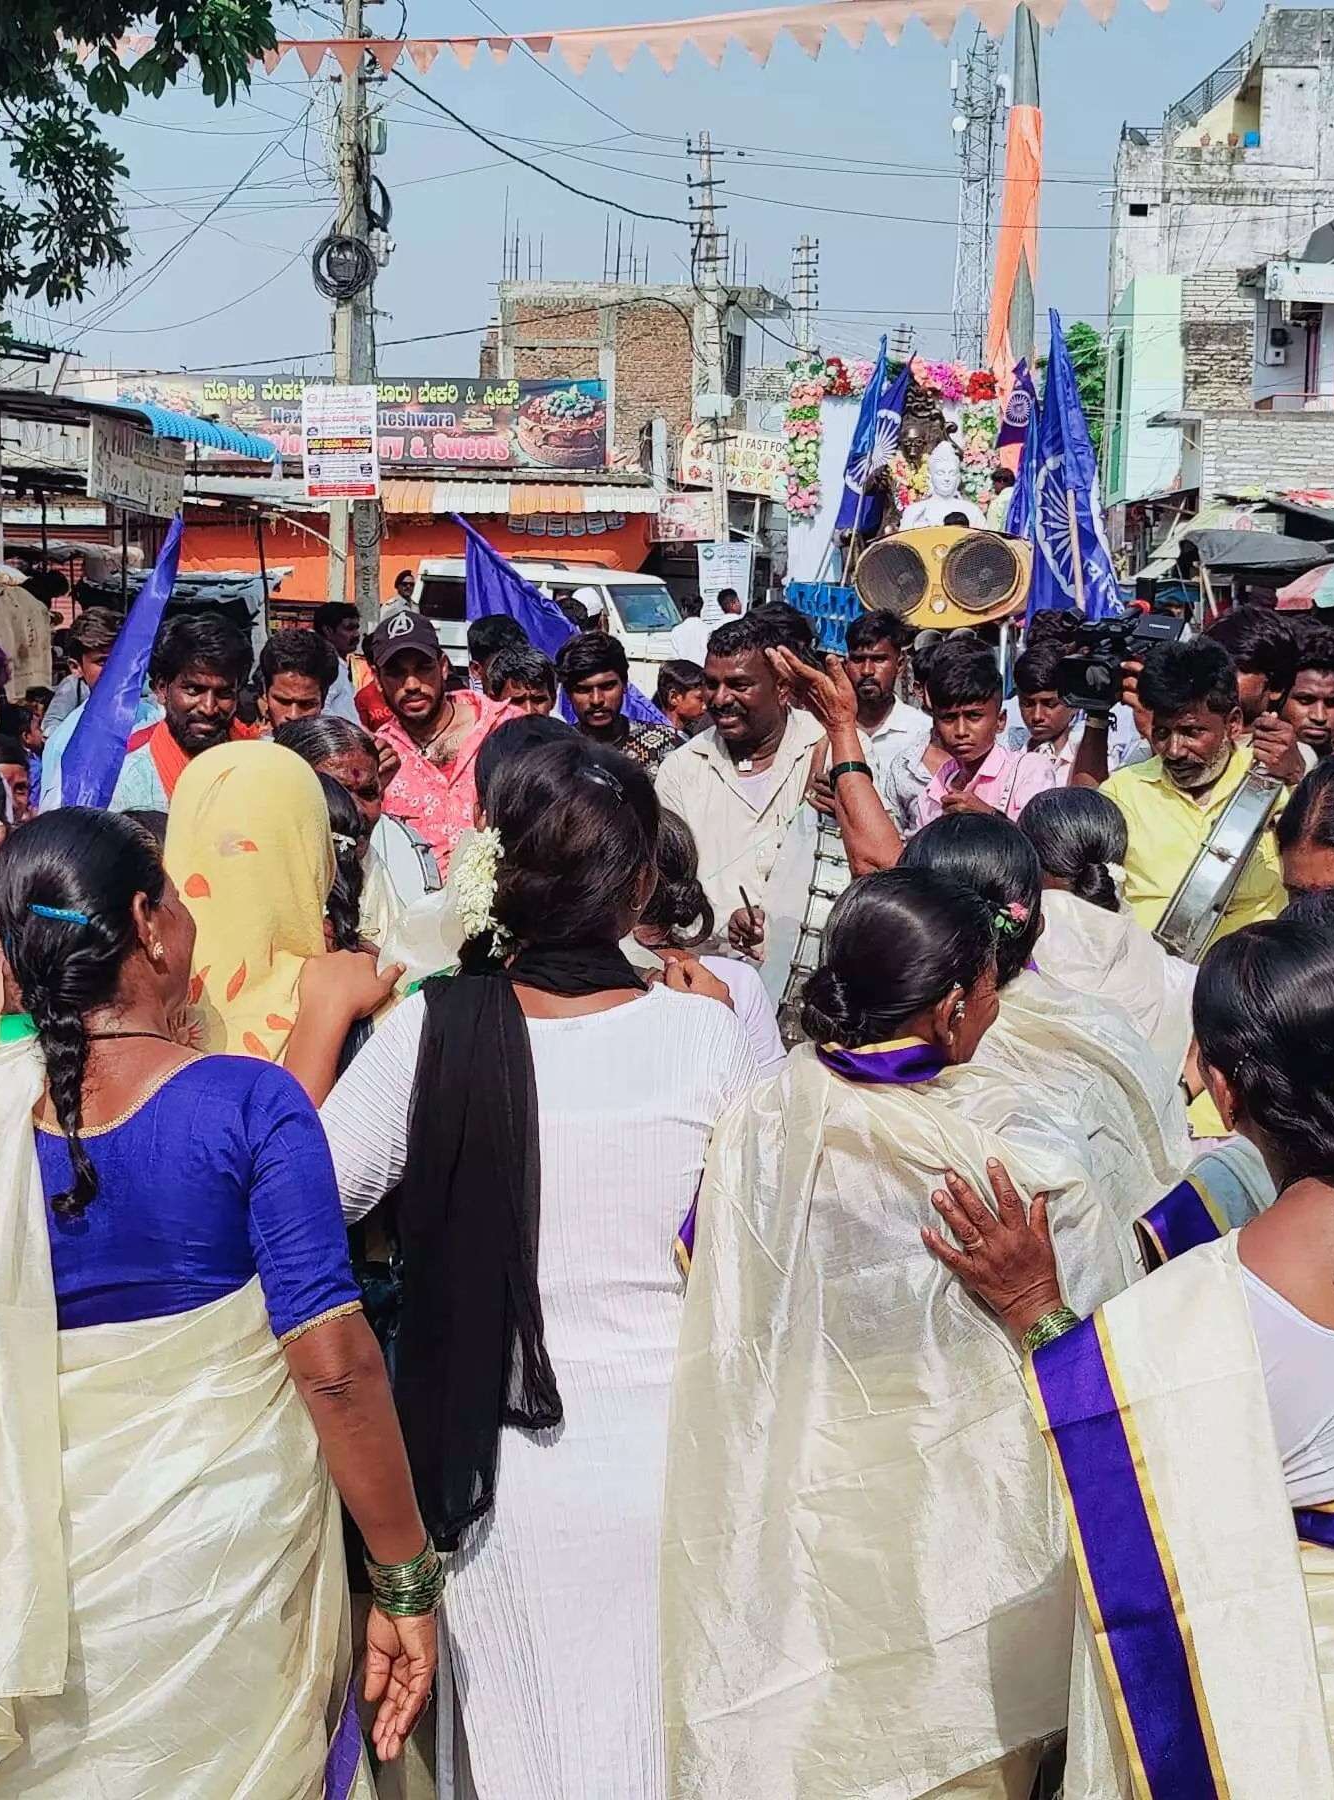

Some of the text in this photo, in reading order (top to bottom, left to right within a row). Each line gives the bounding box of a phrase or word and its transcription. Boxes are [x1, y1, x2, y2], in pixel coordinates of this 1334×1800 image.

[418, 380, 459, 404] ಬೇಕರಿ
[465, 385, 477, 404] &
[377, 411, 456, 430] teshwara
[409, 436, 428, 460] &
[432, 433, 510, 461] Sweets
[746, 437, 769, 451] FAST
[770, 441, 788, 453] FOO
